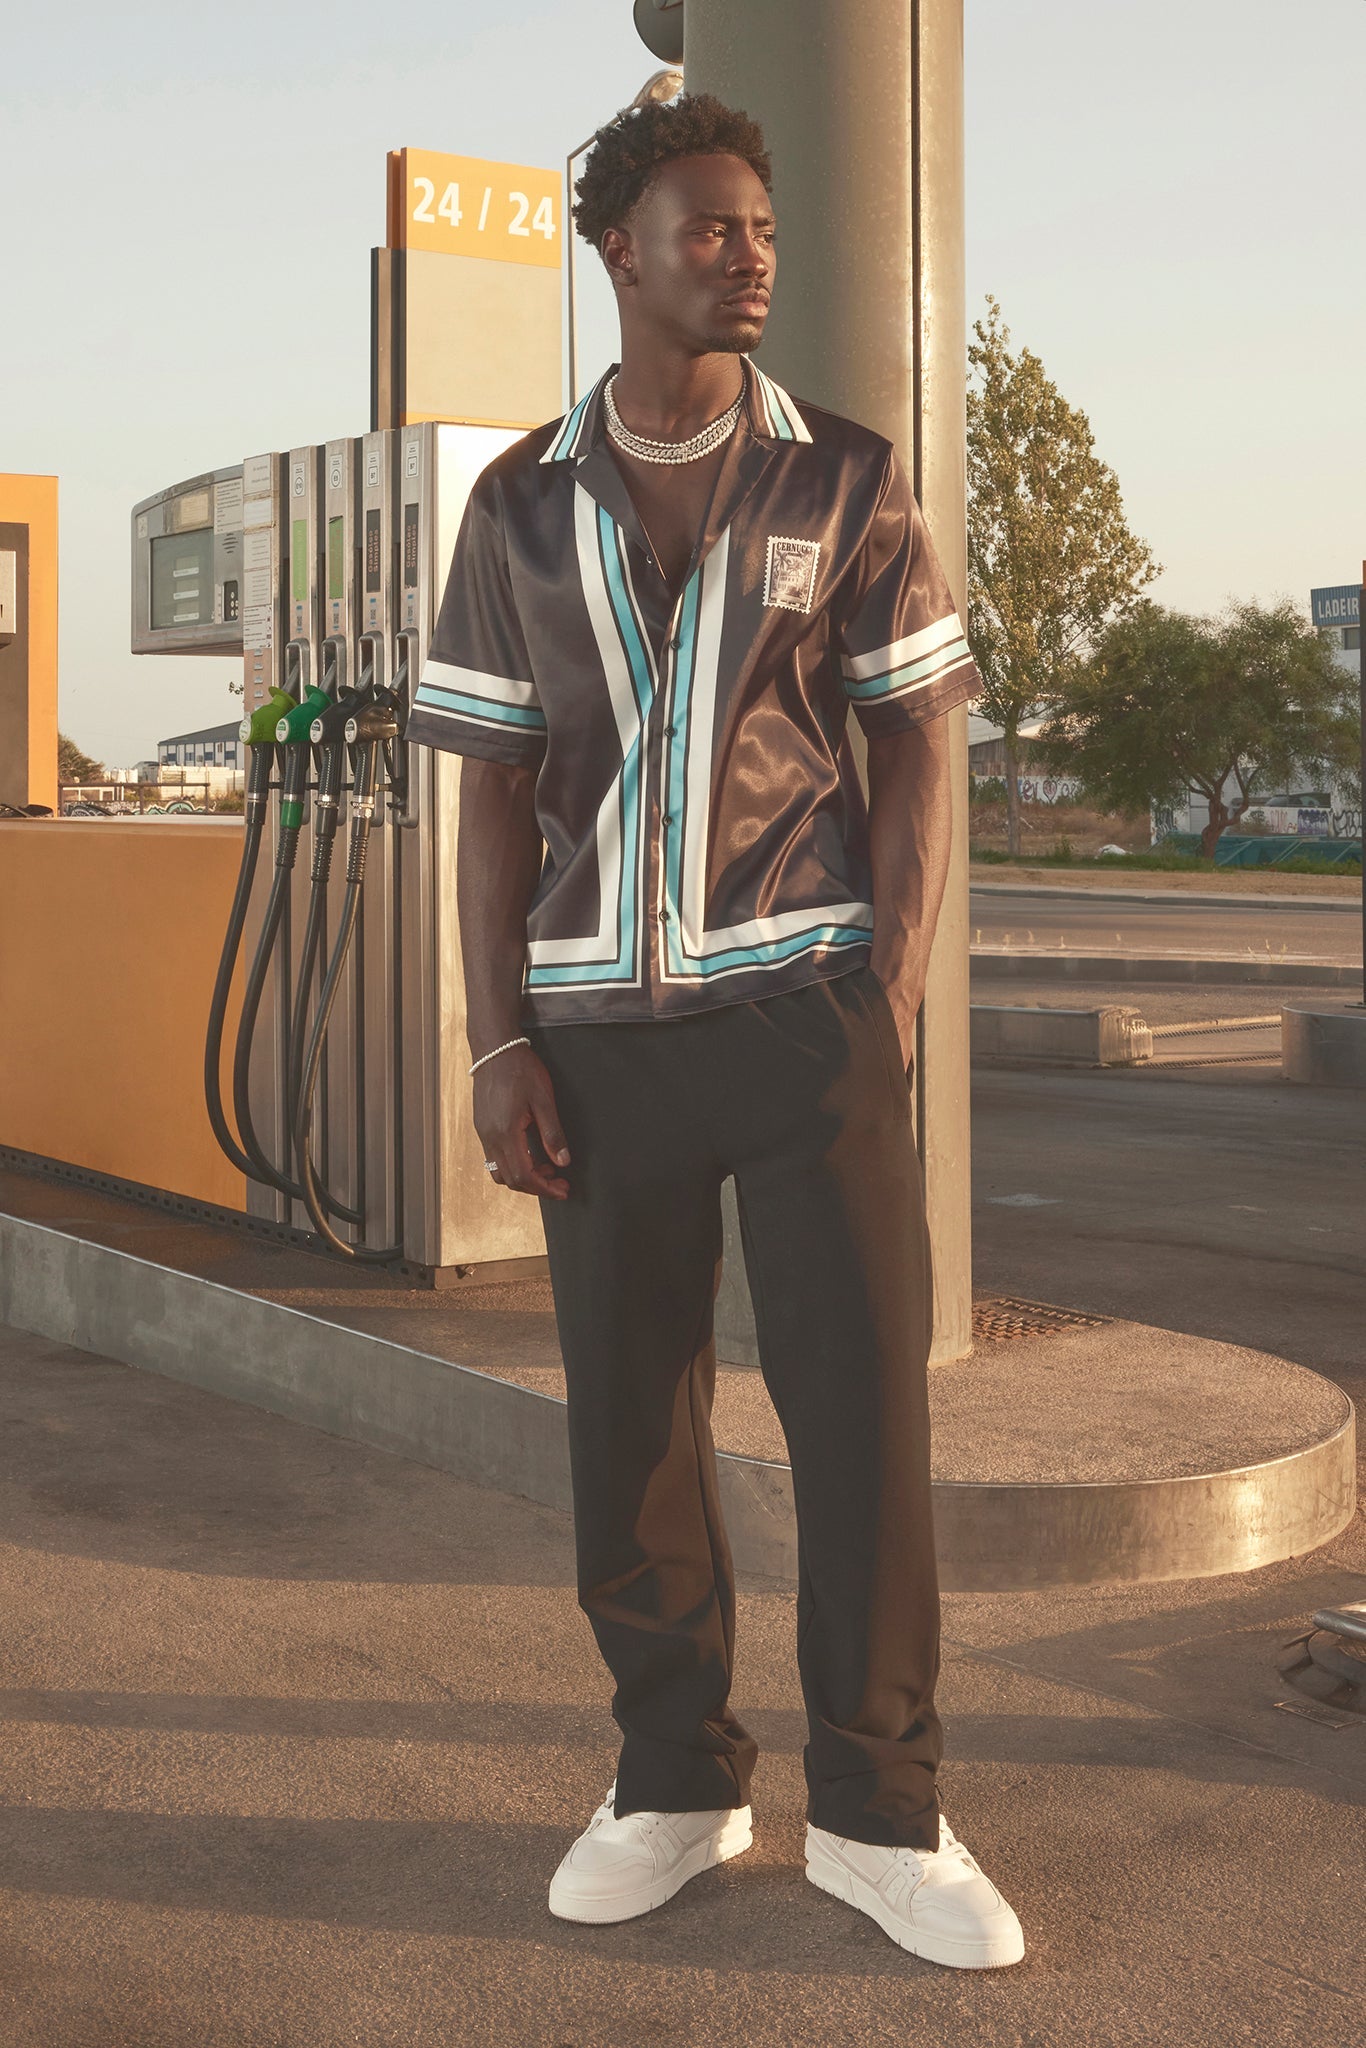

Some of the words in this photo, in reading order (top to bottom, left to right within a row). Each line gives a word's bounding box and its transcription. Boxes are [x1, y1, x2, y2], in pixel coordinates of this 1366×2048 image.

[412, 177, 463, 227] 24
[478, 187, 492, 231] /
[508, 192, 556, 240] 24
[776, 541, 813, 554] CERNUCCI
[1318, 597, 1360, 619] LADEIR
